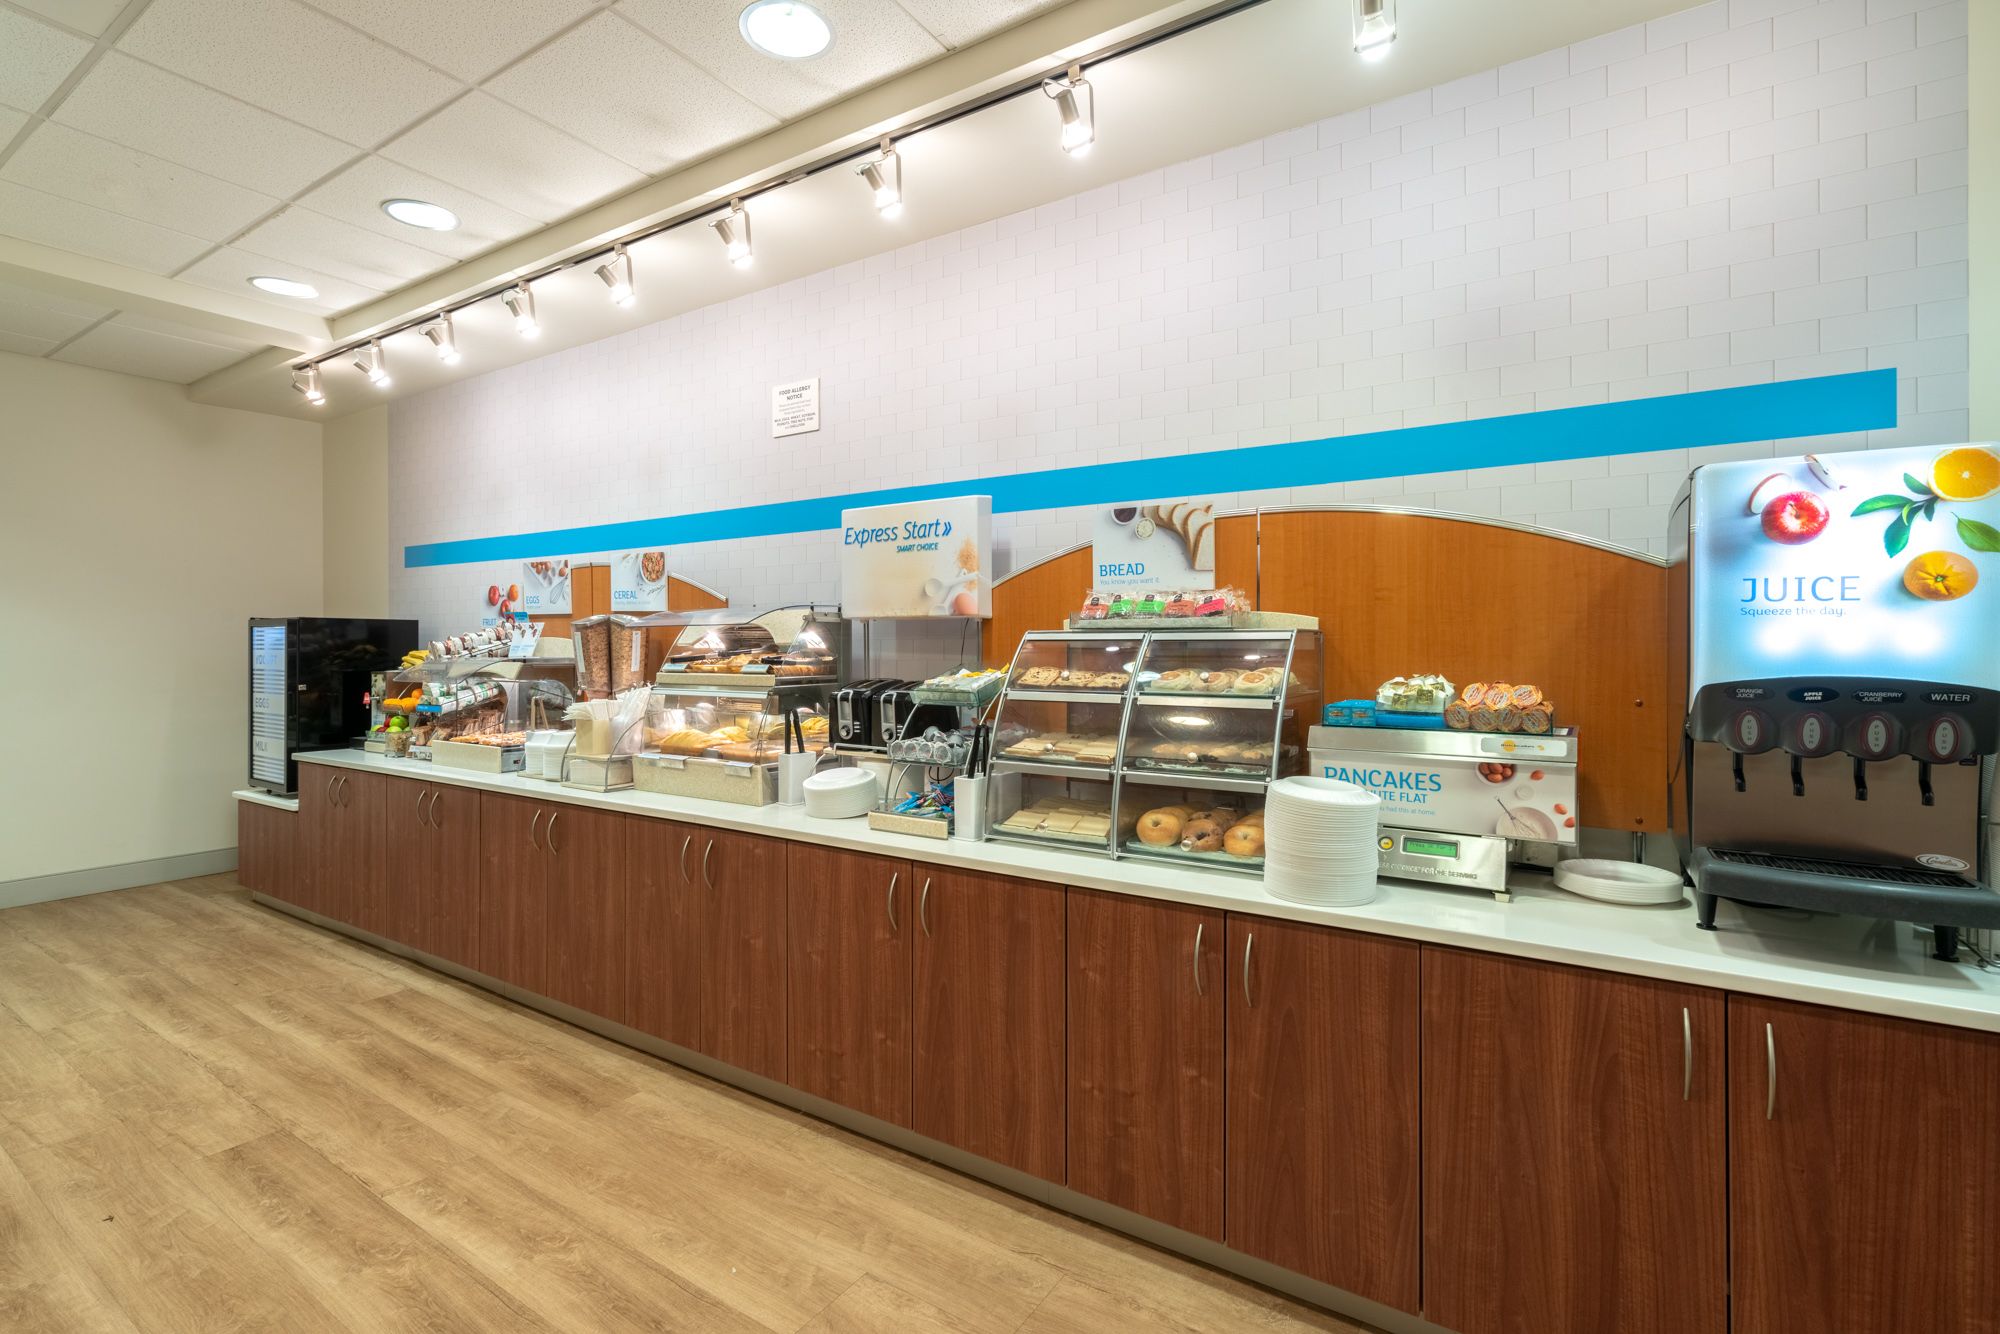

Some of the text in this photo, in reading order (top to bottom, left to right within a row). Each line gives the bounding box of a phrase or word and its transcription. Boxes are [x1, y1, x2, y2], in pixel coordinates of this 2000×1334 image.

[844, 526, 899, 549] Express
[896, 542, 939, 553] SMART CHOICE
[1100, 562, 1145, 577] BREAD
[1100, 578, 1110, 586] You
[613, 590, 638, 600] CEREAL
[1740, 576, 1861, 603] JUICE
[526, 595, 540, 604] EGGS
[1740, 607, 1792, 617] Squeeze
[1796, 606, 1816, 616] the
[482, 618, 497, 626] FRUIT
[1931, 693, 1971, 702] WATER
[1324, 766, 1442, 792] PANCAKES
[1400, 792, 1428, 804] FLAT
[1398, 806, 1410, 814] this
